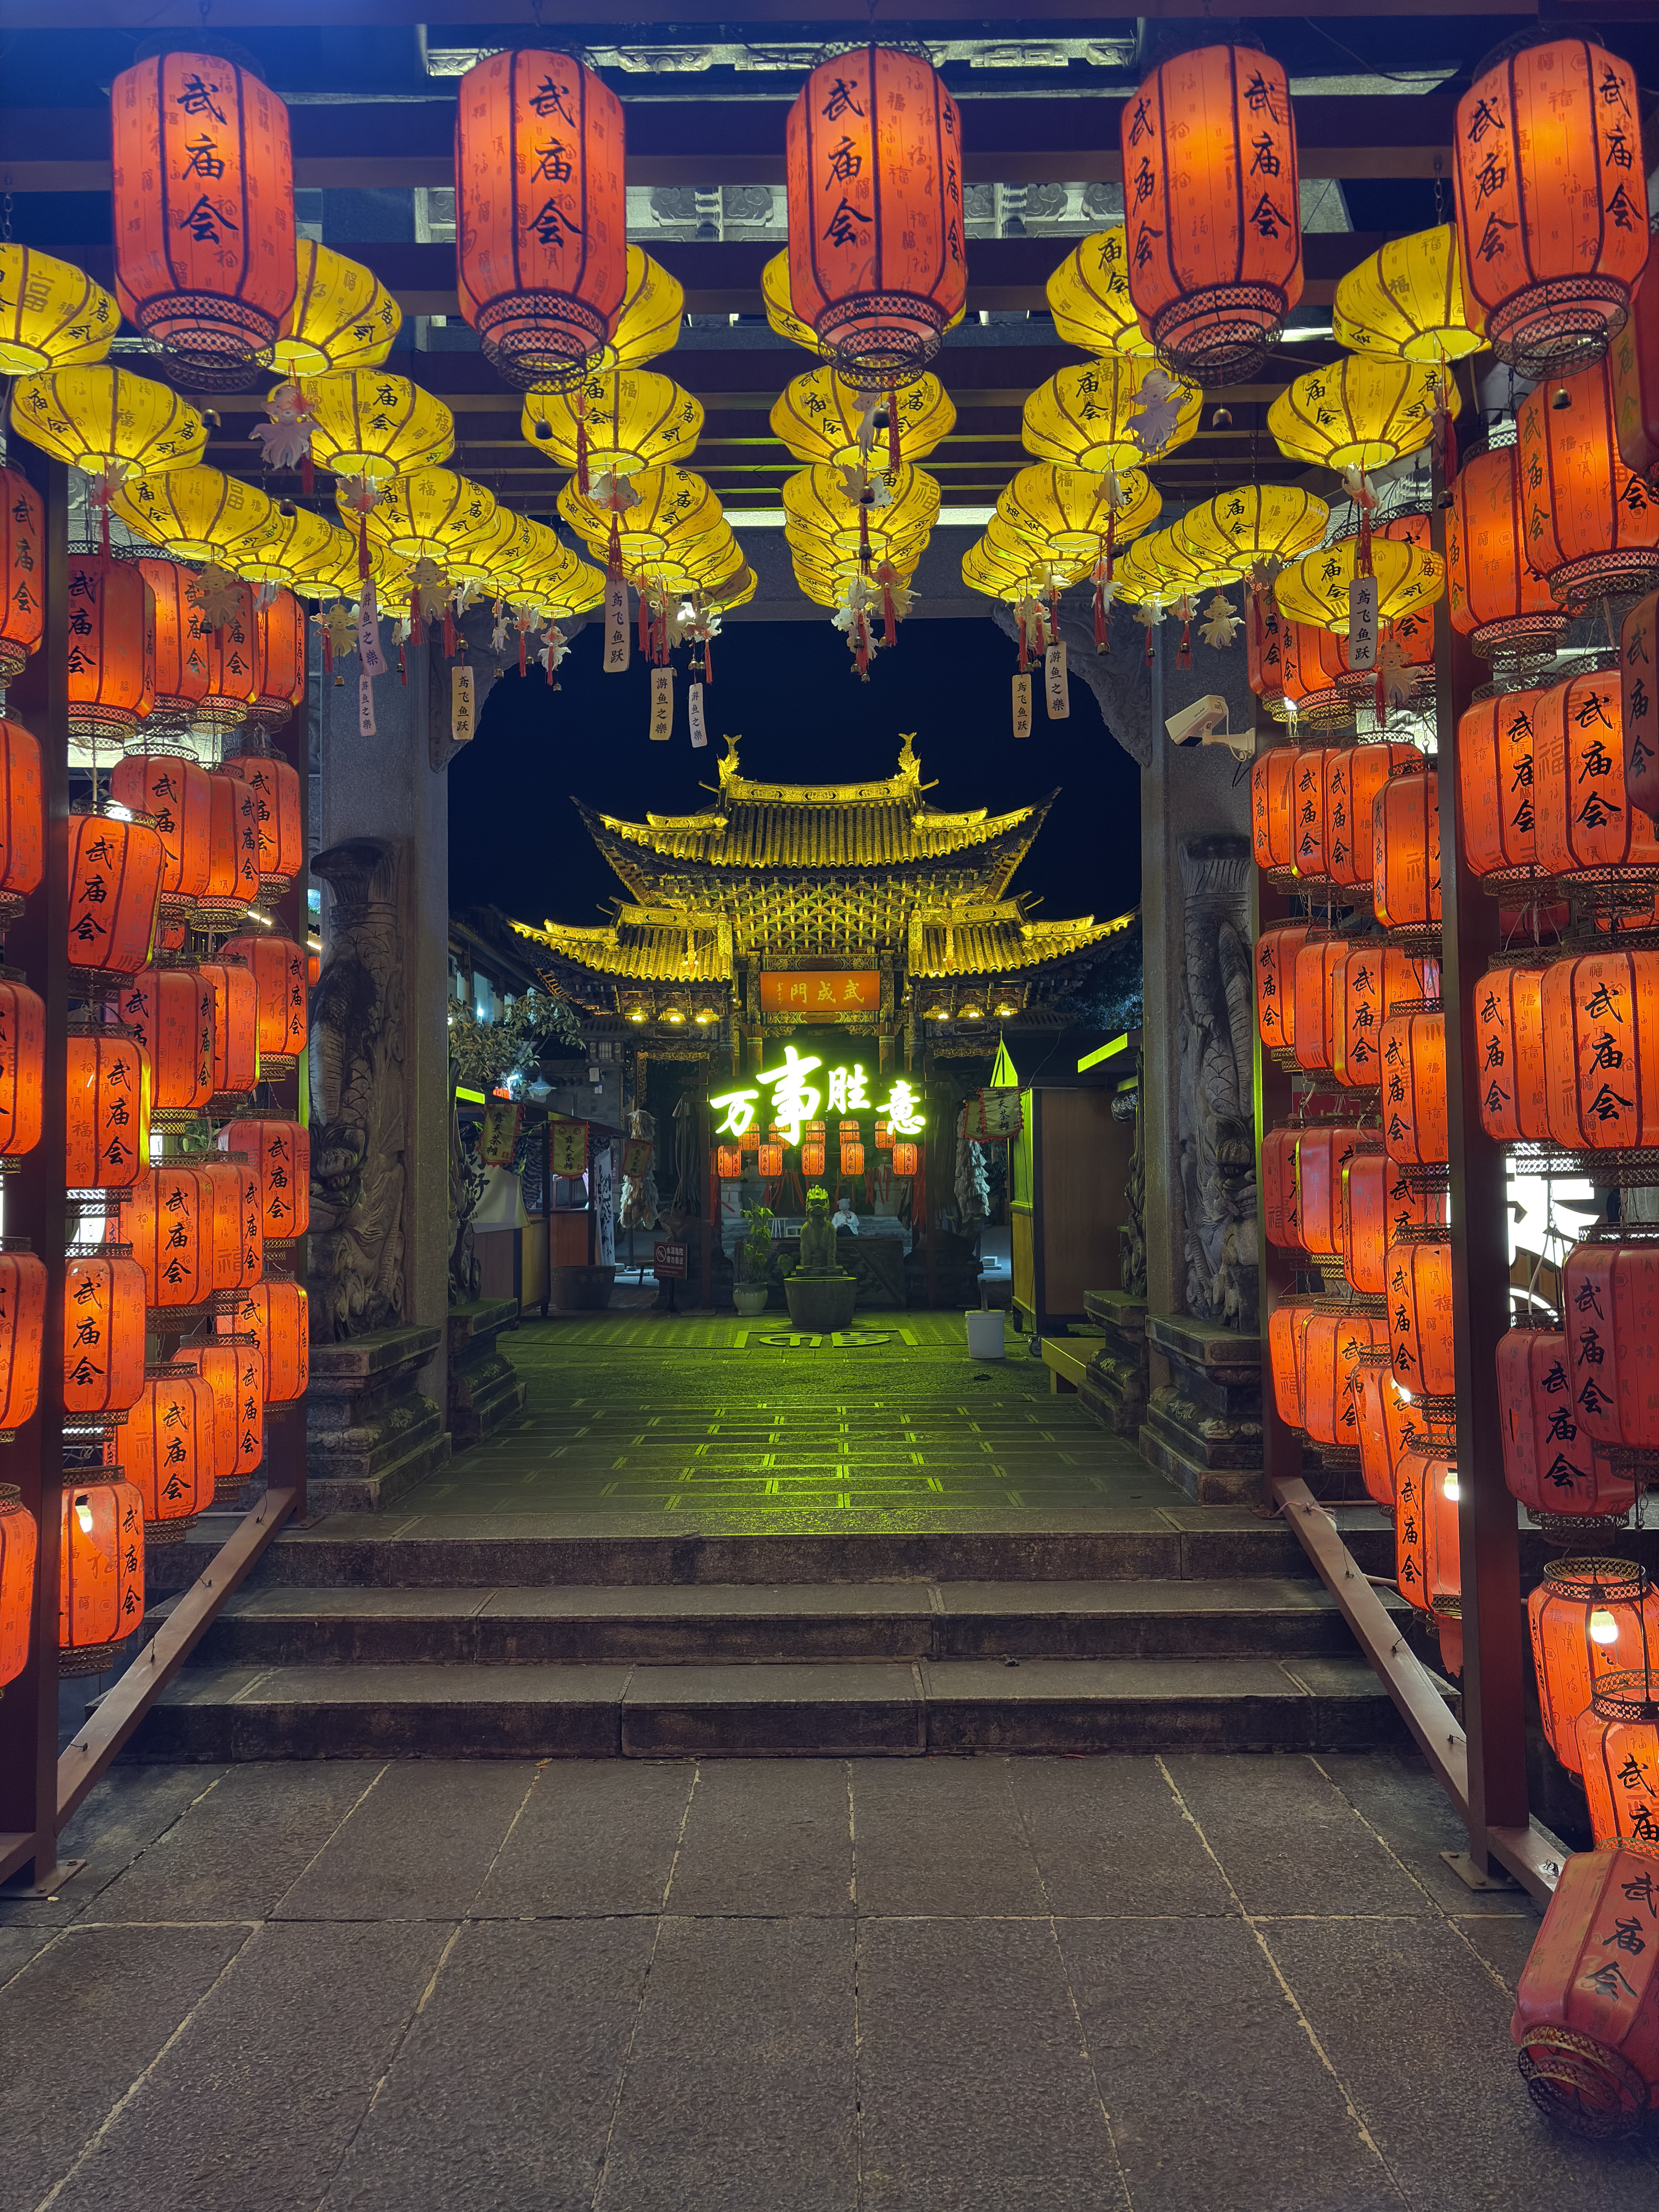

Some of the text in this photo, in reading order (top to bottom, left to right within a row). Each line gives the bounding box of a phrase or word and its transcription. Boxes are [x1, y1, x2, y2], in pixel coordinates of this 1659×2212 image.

[176, 74, 239, 245] 武庙会
[526, 75, 582, 248] 武庙会
[822, 77, 873, 248] 武庙会
[1128, 97, 1163, 269] 武庙会
[1244, 70, 1291, 239] 武庙会
[1468, 97, 1519, 262] 武庙会
[1600, 66, 1644, 232] 武庙会
[1522, 406, 1550, 544] 武庙会
[12, 495, 39, 615] 武庙会
[68, 571, 96, 675] 武庙会
[609, 591, 625, 664] 鸢飞鱼跃
[1354, 588, 1372, 662] 鸢飞鱼跃
[456, 675, 470, 732] 鸢飞鱼跃
[1017, 681, 1028, 731] 鸢飞鱼跃
[1627, 623, 1655, 779] 武庙会
[1253, 770, 1268, 849] 武庙会
[1298, 769, 1321, 857] 武庙会
[1575, 691, 1622, 829] 武庙会
[241, 796, 258, 882] 武庙会
[1329, 769, 1349, 864] 武庙会
[71, 836, 113, 942] 武庙会
[289, 955, 304, 1037] 武庙会
[1259, 945, 1280, 1027] 武庙会
[1349, 966, 1379, 1063] 武庙会
[197, 992, 211, 1088] 武庙会
[1384, 1036, 1411, 1142] 武庙会
[1480, 991, 1511, 1114] 武庙会
[1584, 982, 1634, 1121] 武庙会
[102, 1059, 133, 1166] 武庙会
[709, 1045, 926, 1146] 万事胜意
[243, 1182, 260, 1270] 武庙会
[266, 1136, 292, 1220] 武庙会
[162, 1187, 191, 1285] 武庙会
[68, 1277, 105, 1386] 武庙会
[1392, 1265, 1417, 1371] 武庙会
[1574, 1276, 1615, 1415] 武庙会
[160, 1401, 191, 1501] 武庙会
[239, 1363, 260, 1455] 武庙会
[1541, 1360, 1587, 1489] 武庙会
[122, 1504, 141, 1616] 武庙会
[1400, 1476, 1422, 1584] 武庙会
[1585, 1871, 1659, 2002] 武庙会
